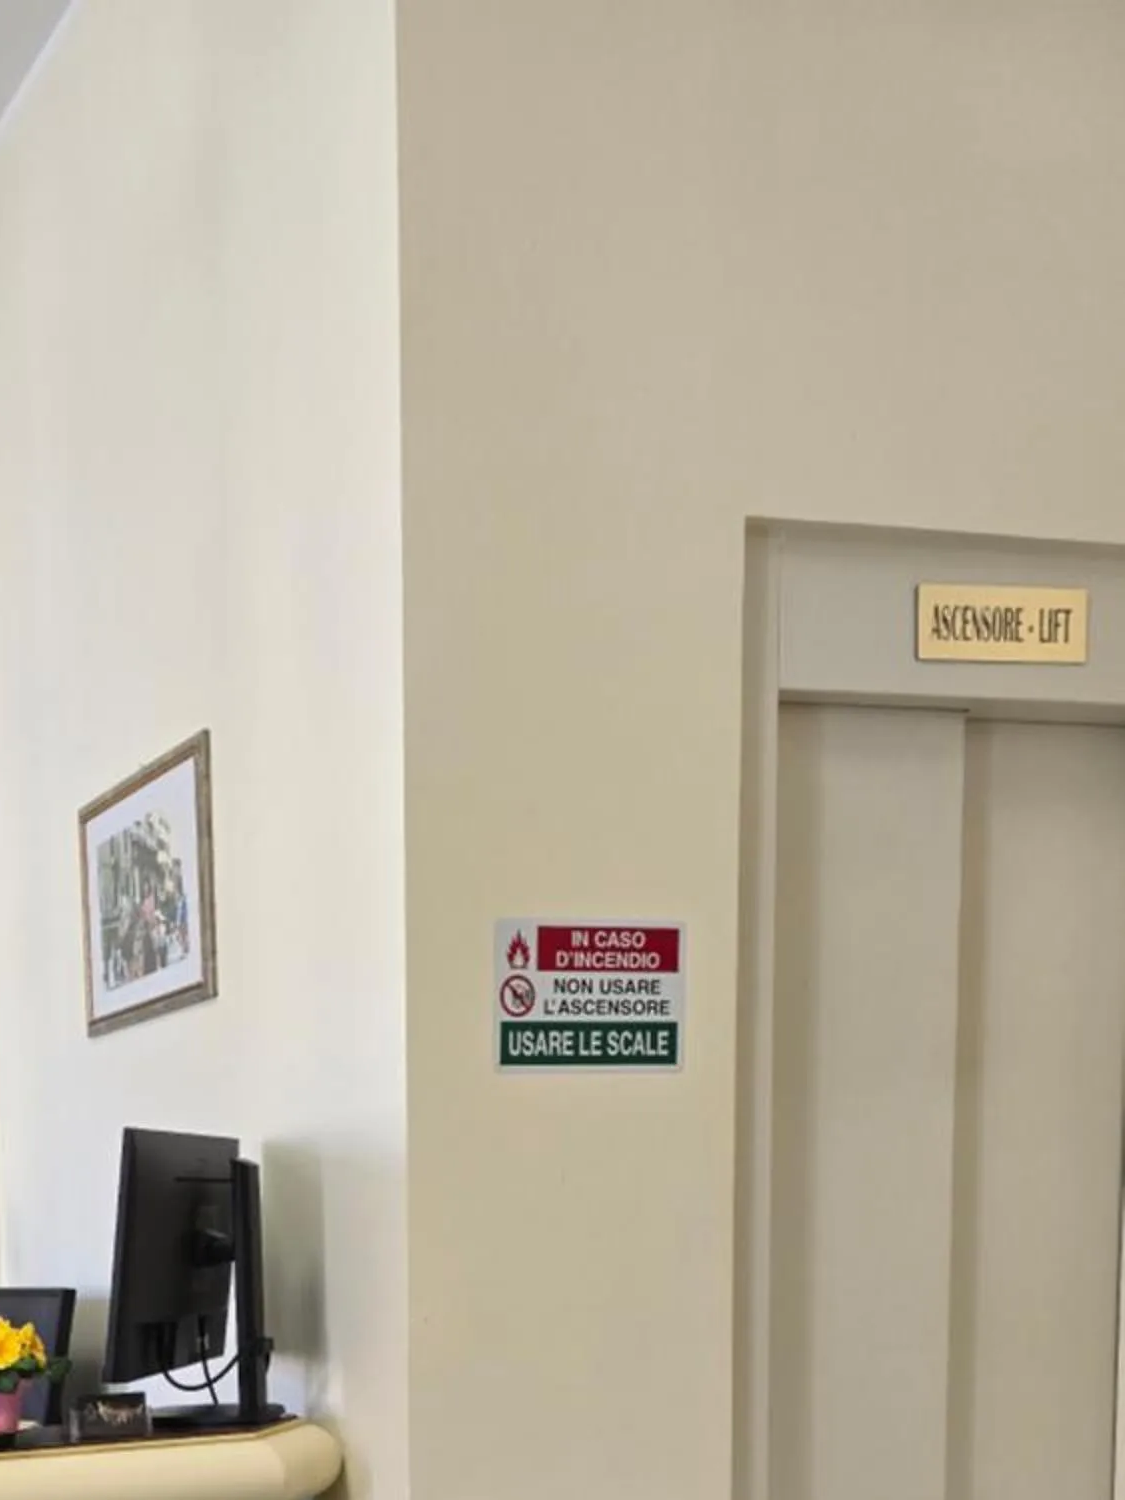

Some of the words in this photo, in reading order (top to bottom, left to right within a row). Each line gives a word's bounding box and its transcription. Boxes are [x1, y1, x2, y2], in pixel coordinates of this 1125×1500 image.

[932, 604, 1024, 642] ASCENSORE
[1038, 608, 1073, 643] LIFT
[571, 931, 589, 946] IN
[594, 931, 646, 948] CASO
[556, 952, 660, 968] D'INCENDIO
[553, 979, 593, 994] NON
[599, 979, 660, 995] USARE
[544, 1000, 670, 1015] L'ASCENSORE
[509, 1031, 574, 1056] USARE
[579, 1031, 602, 1056] LE
[607, 1031, 669, 1056] SCALE
